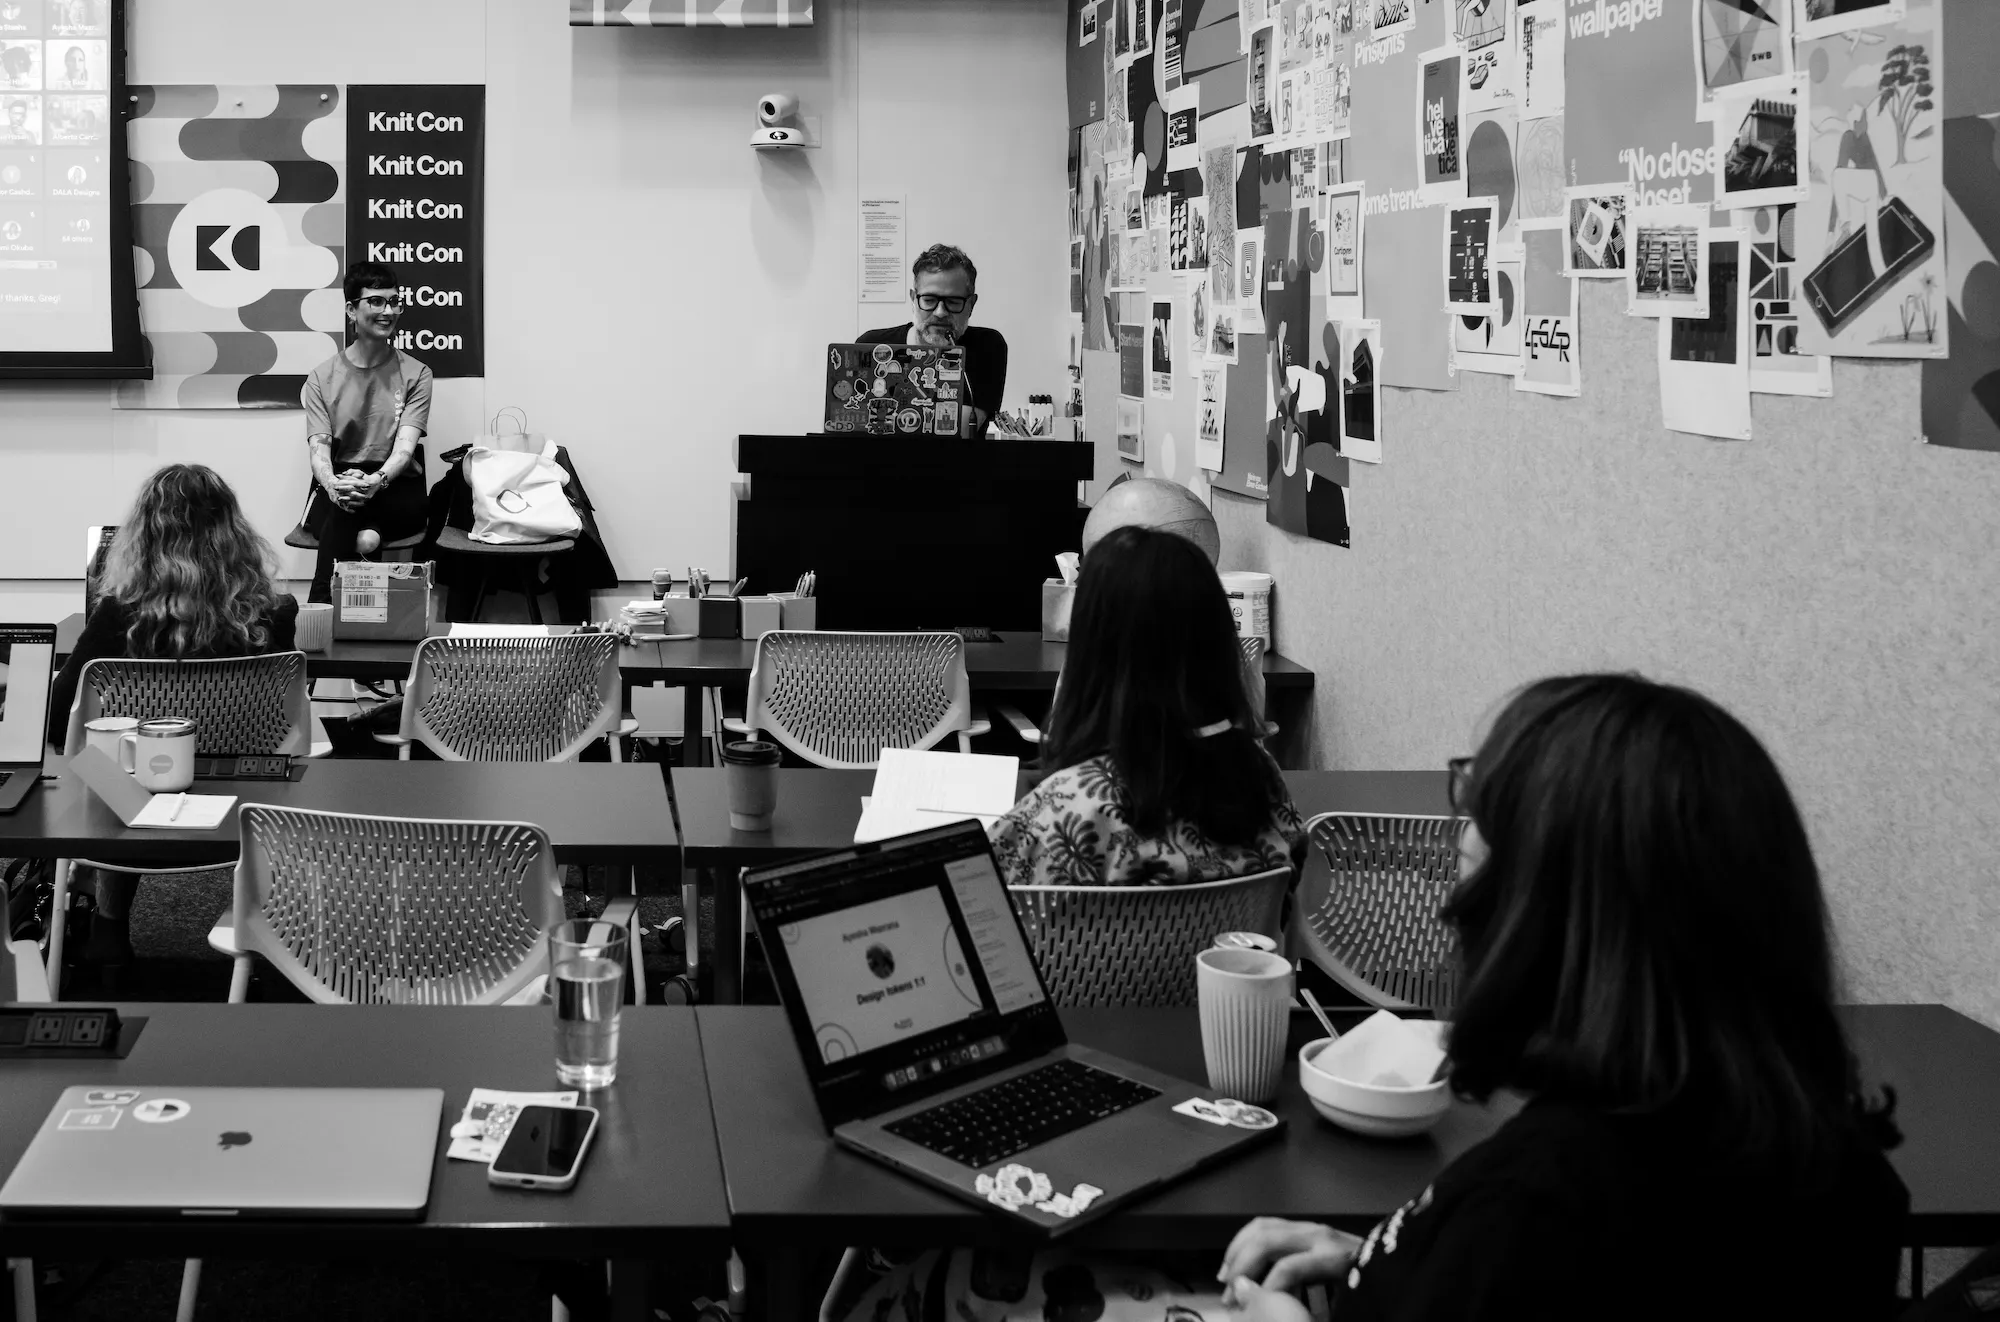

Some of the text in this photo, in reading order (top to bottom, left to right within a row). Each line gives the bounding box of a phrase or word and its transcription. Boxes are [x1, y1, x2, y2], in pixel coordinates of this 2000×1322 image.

[1569, 0, 1662, 39] wallpaper
[1752, 51, 1772, 62] SWB
[1427, 96, 1444, 121] hel
[368, 111, 464, 132] Knit Con
[1430, 119, 1444, 137] ve
[1424, 133, 1446, 156] tica
[368, 155, 464, 176] Knit Con
[1438, 152, 1457, 175] tica
[52, 188, 101, 198] DALA Designs
[368, 198, 463, 219] Knit Con
[1365, 193, 1389, 216] ome
[368, 242, 463, 263] Knit Con
[5, 293, 37, 303] thanks,
[398, 286, 463, 306] it Con
[415, 330, 463, 350] Con
